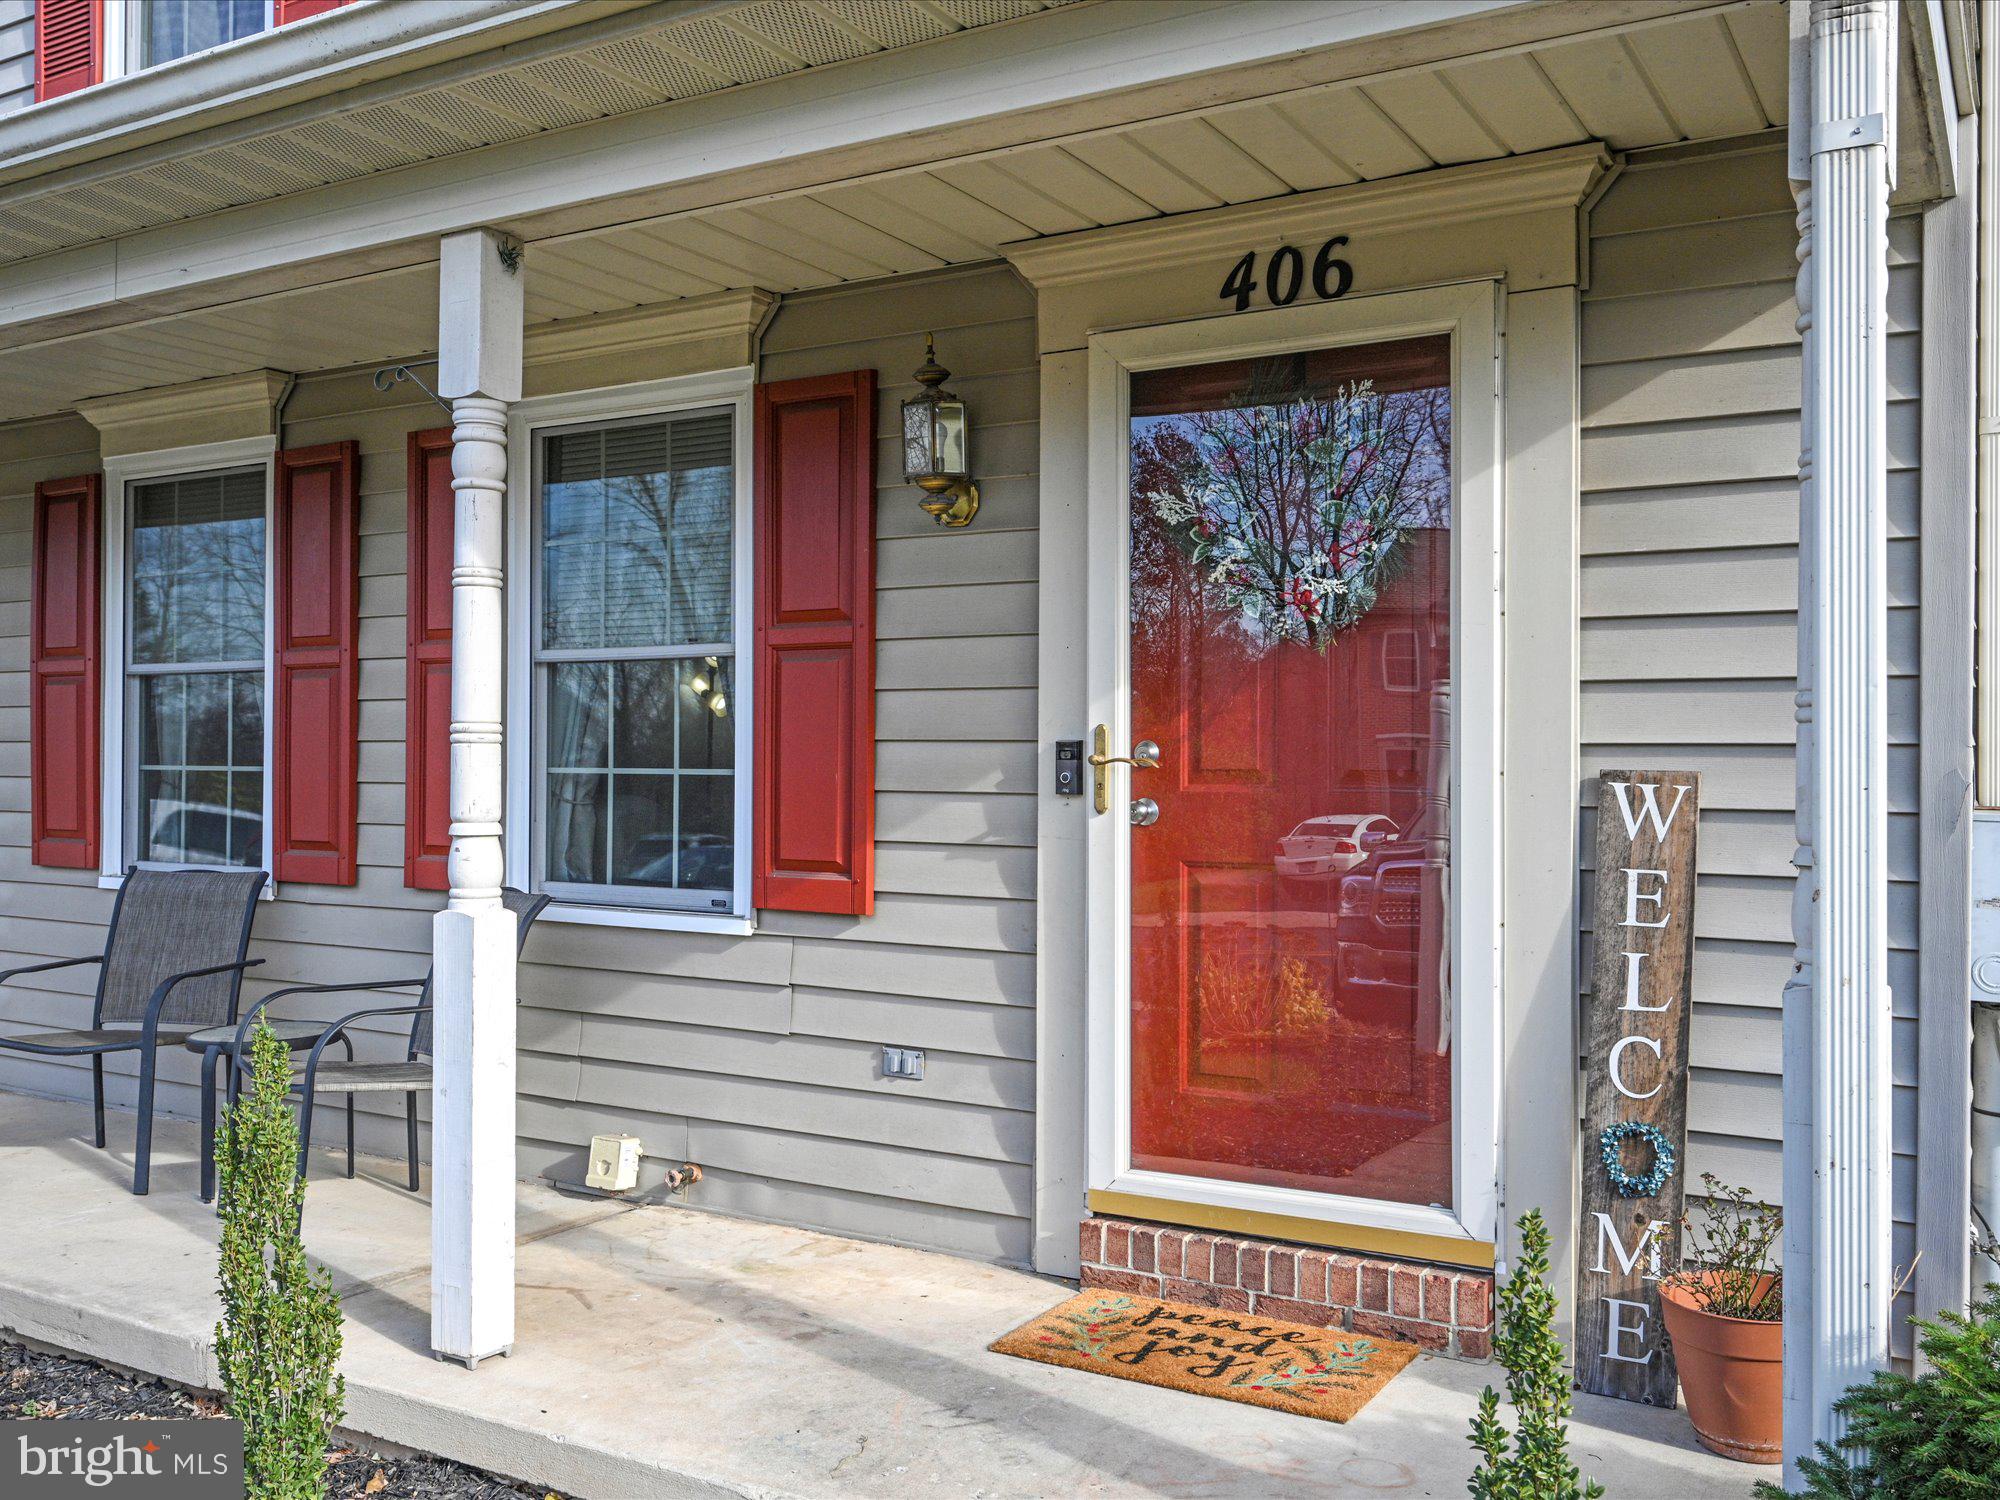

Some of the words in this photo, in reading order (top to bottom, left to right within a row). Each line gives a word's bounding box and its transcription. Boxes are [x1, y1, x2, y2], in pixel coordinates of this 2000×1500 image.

[1219, 235, 1354, 312] 406
[1131, 1305, 1322, 1344] peace
[1148, 1326, 1288, 1357] and
[1113, 1340, 1256, 1379] joy
